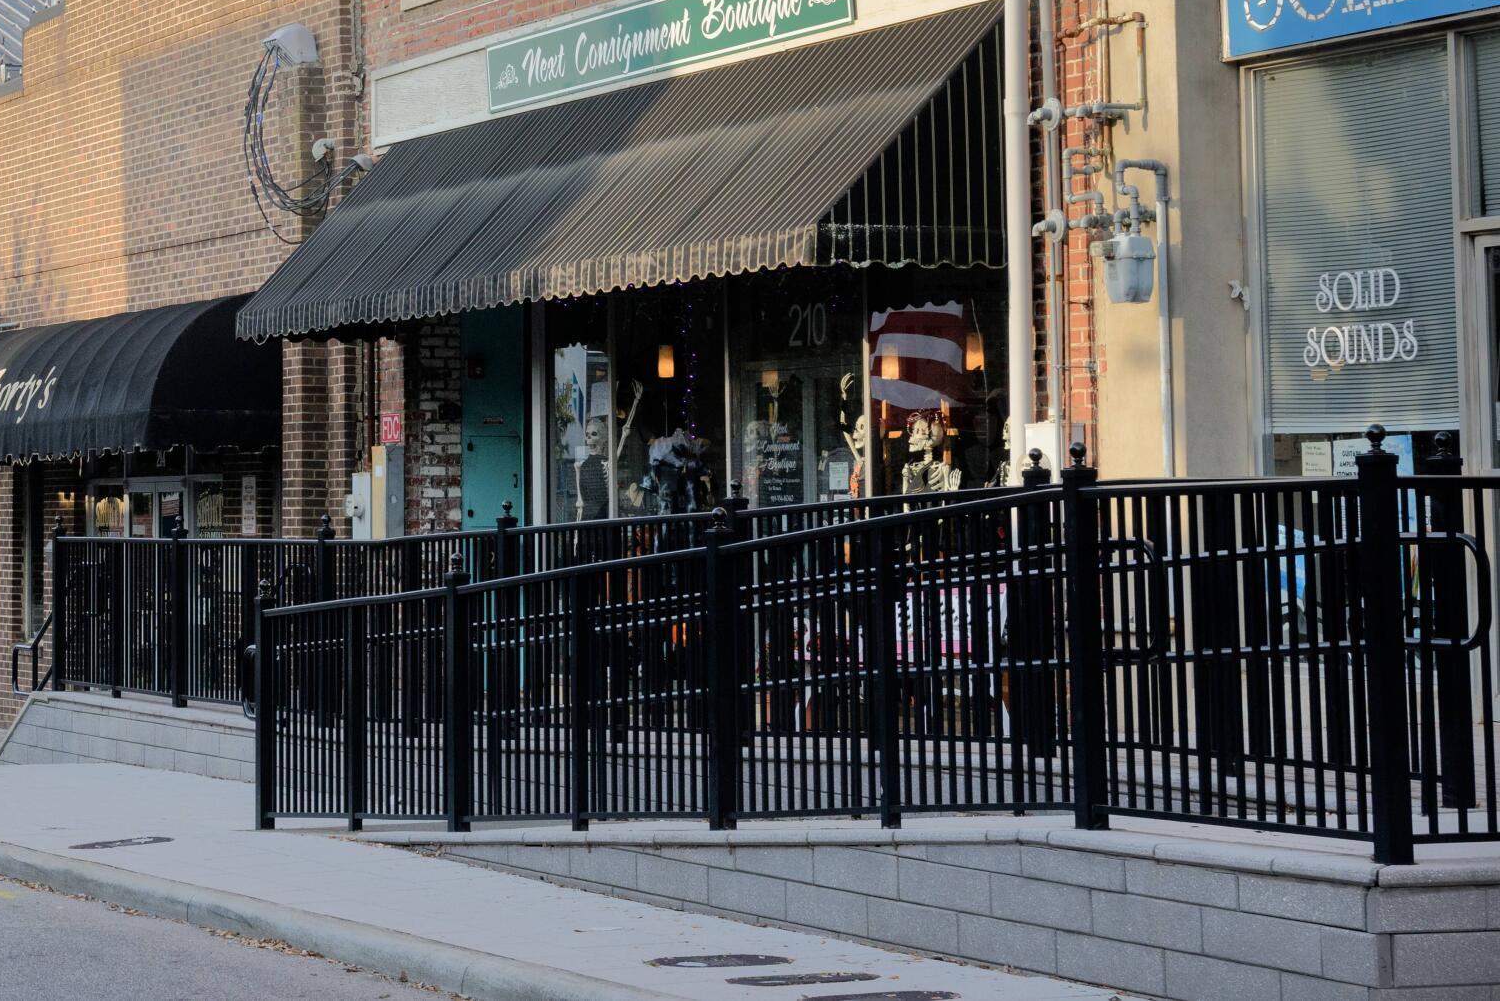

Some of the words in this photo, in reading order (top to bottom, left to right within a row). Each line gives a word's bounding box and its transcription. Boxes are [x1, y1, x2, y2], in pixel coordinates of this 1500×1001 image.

[522, 47, 566, 87] Next
[574, 8, 693, 75] Consignment
[1316, 268, 1400, 312] SOLID
[788, 302, 827, 346] 210
[1303, 319, 1418, 367] SOUNDS
[382, 415, 400, 440] FDC
